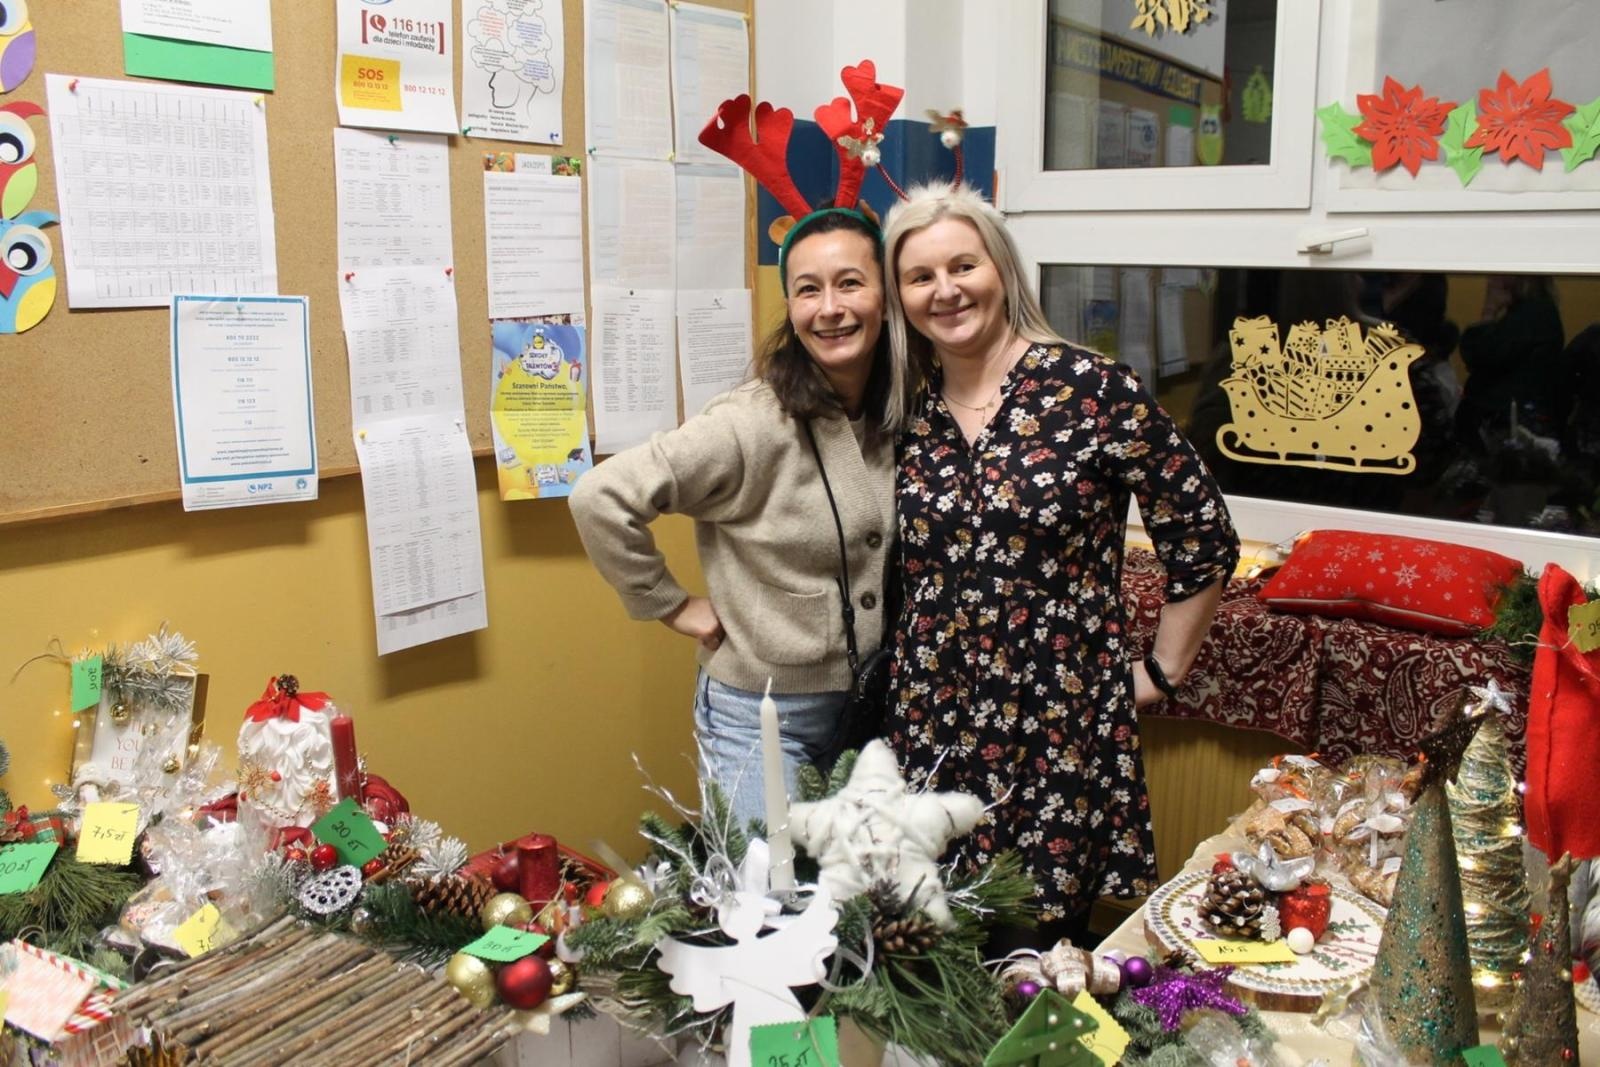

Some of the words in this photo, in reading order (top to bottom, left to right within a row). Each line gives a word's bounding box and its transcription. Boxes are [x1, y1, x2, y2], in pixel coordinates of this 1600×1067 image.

[392, 17, 413, 32] 116
[416, 21, 435, 36] 111
[373, 35, 383, 43] dla
[384, 36, 401, 46] dzieci
[389, 30, 409, 40] telefon
[358, 67, 384, 81] SOS
[512, 382, 539, 390] Szanowni
[331, 821, 351, 838] 20
